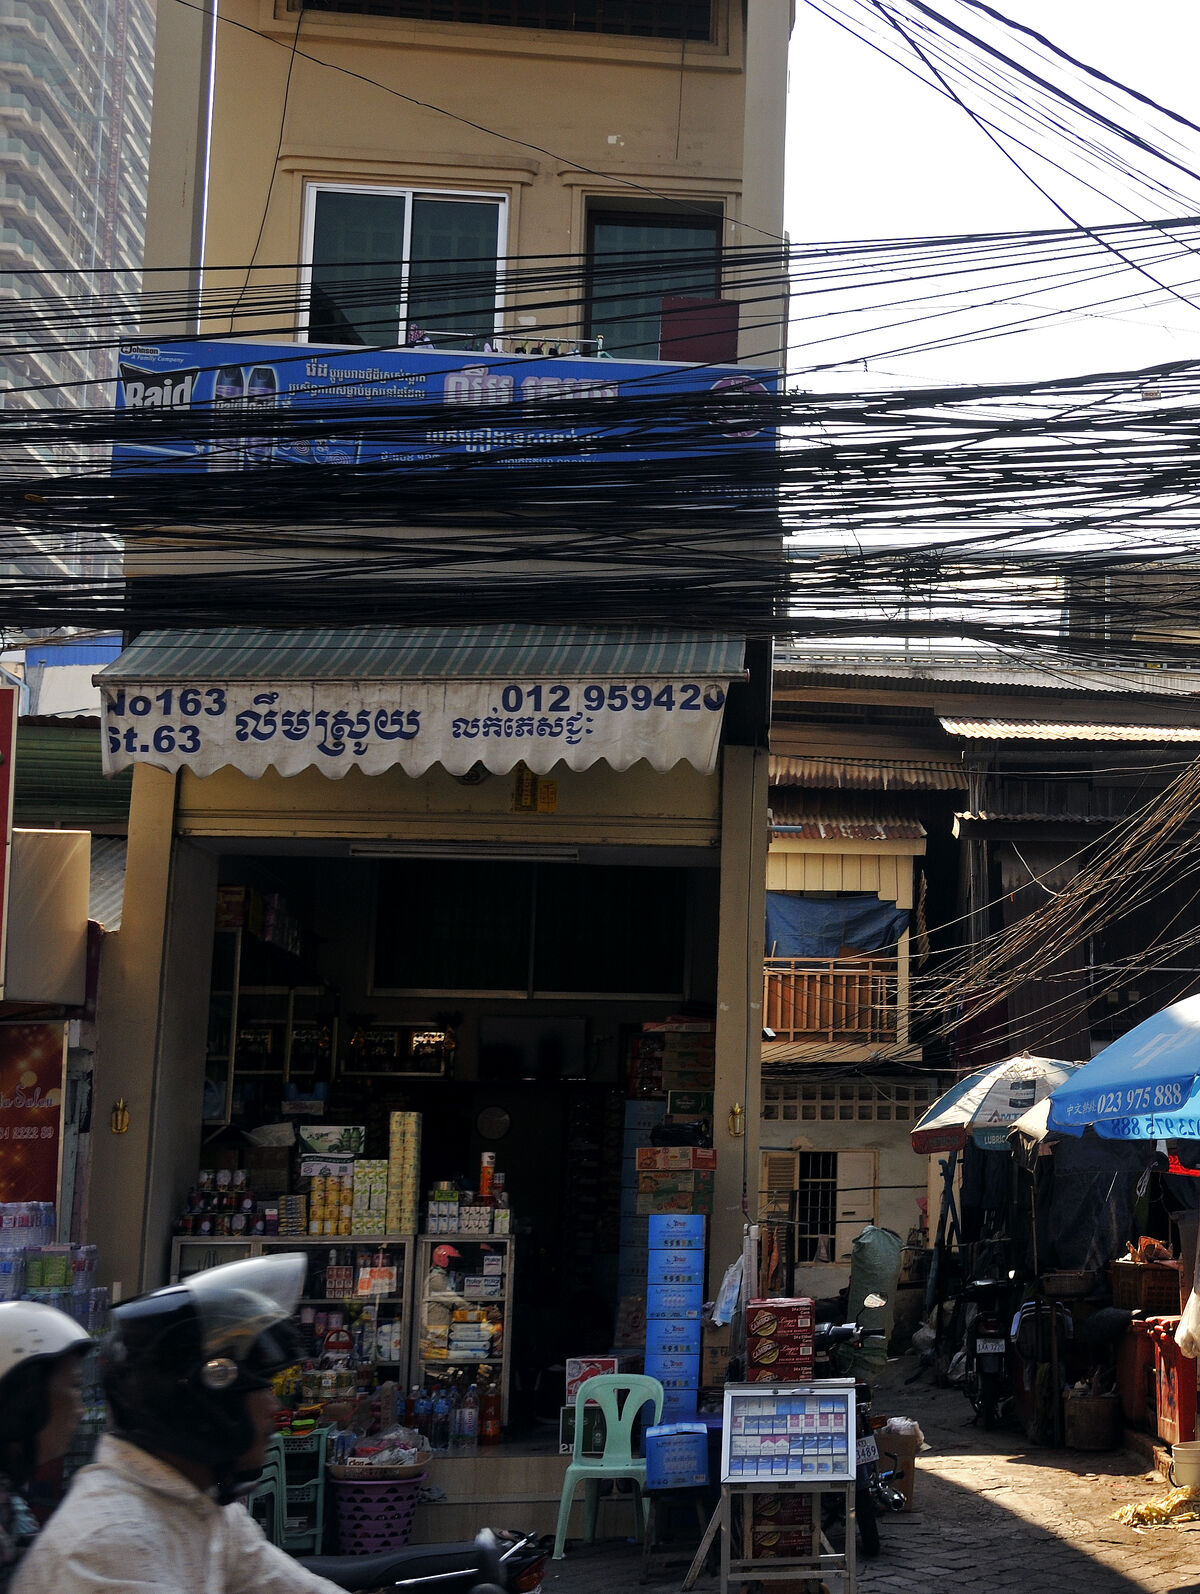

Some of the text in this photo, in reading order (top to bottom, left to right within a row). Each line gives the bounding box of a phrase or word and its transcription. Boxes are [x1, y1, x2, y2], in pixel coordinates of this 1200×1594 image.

[157, 356, 184, 364] Company
[125, 375, 193, 411] Raid
[502, 684, 725, 712] 012 959420
[1097, 1091, 1122, 1114] 023
[1126, 1086, 1151, 1111] 975
[1153, 1082, 1182, 1107] 888
